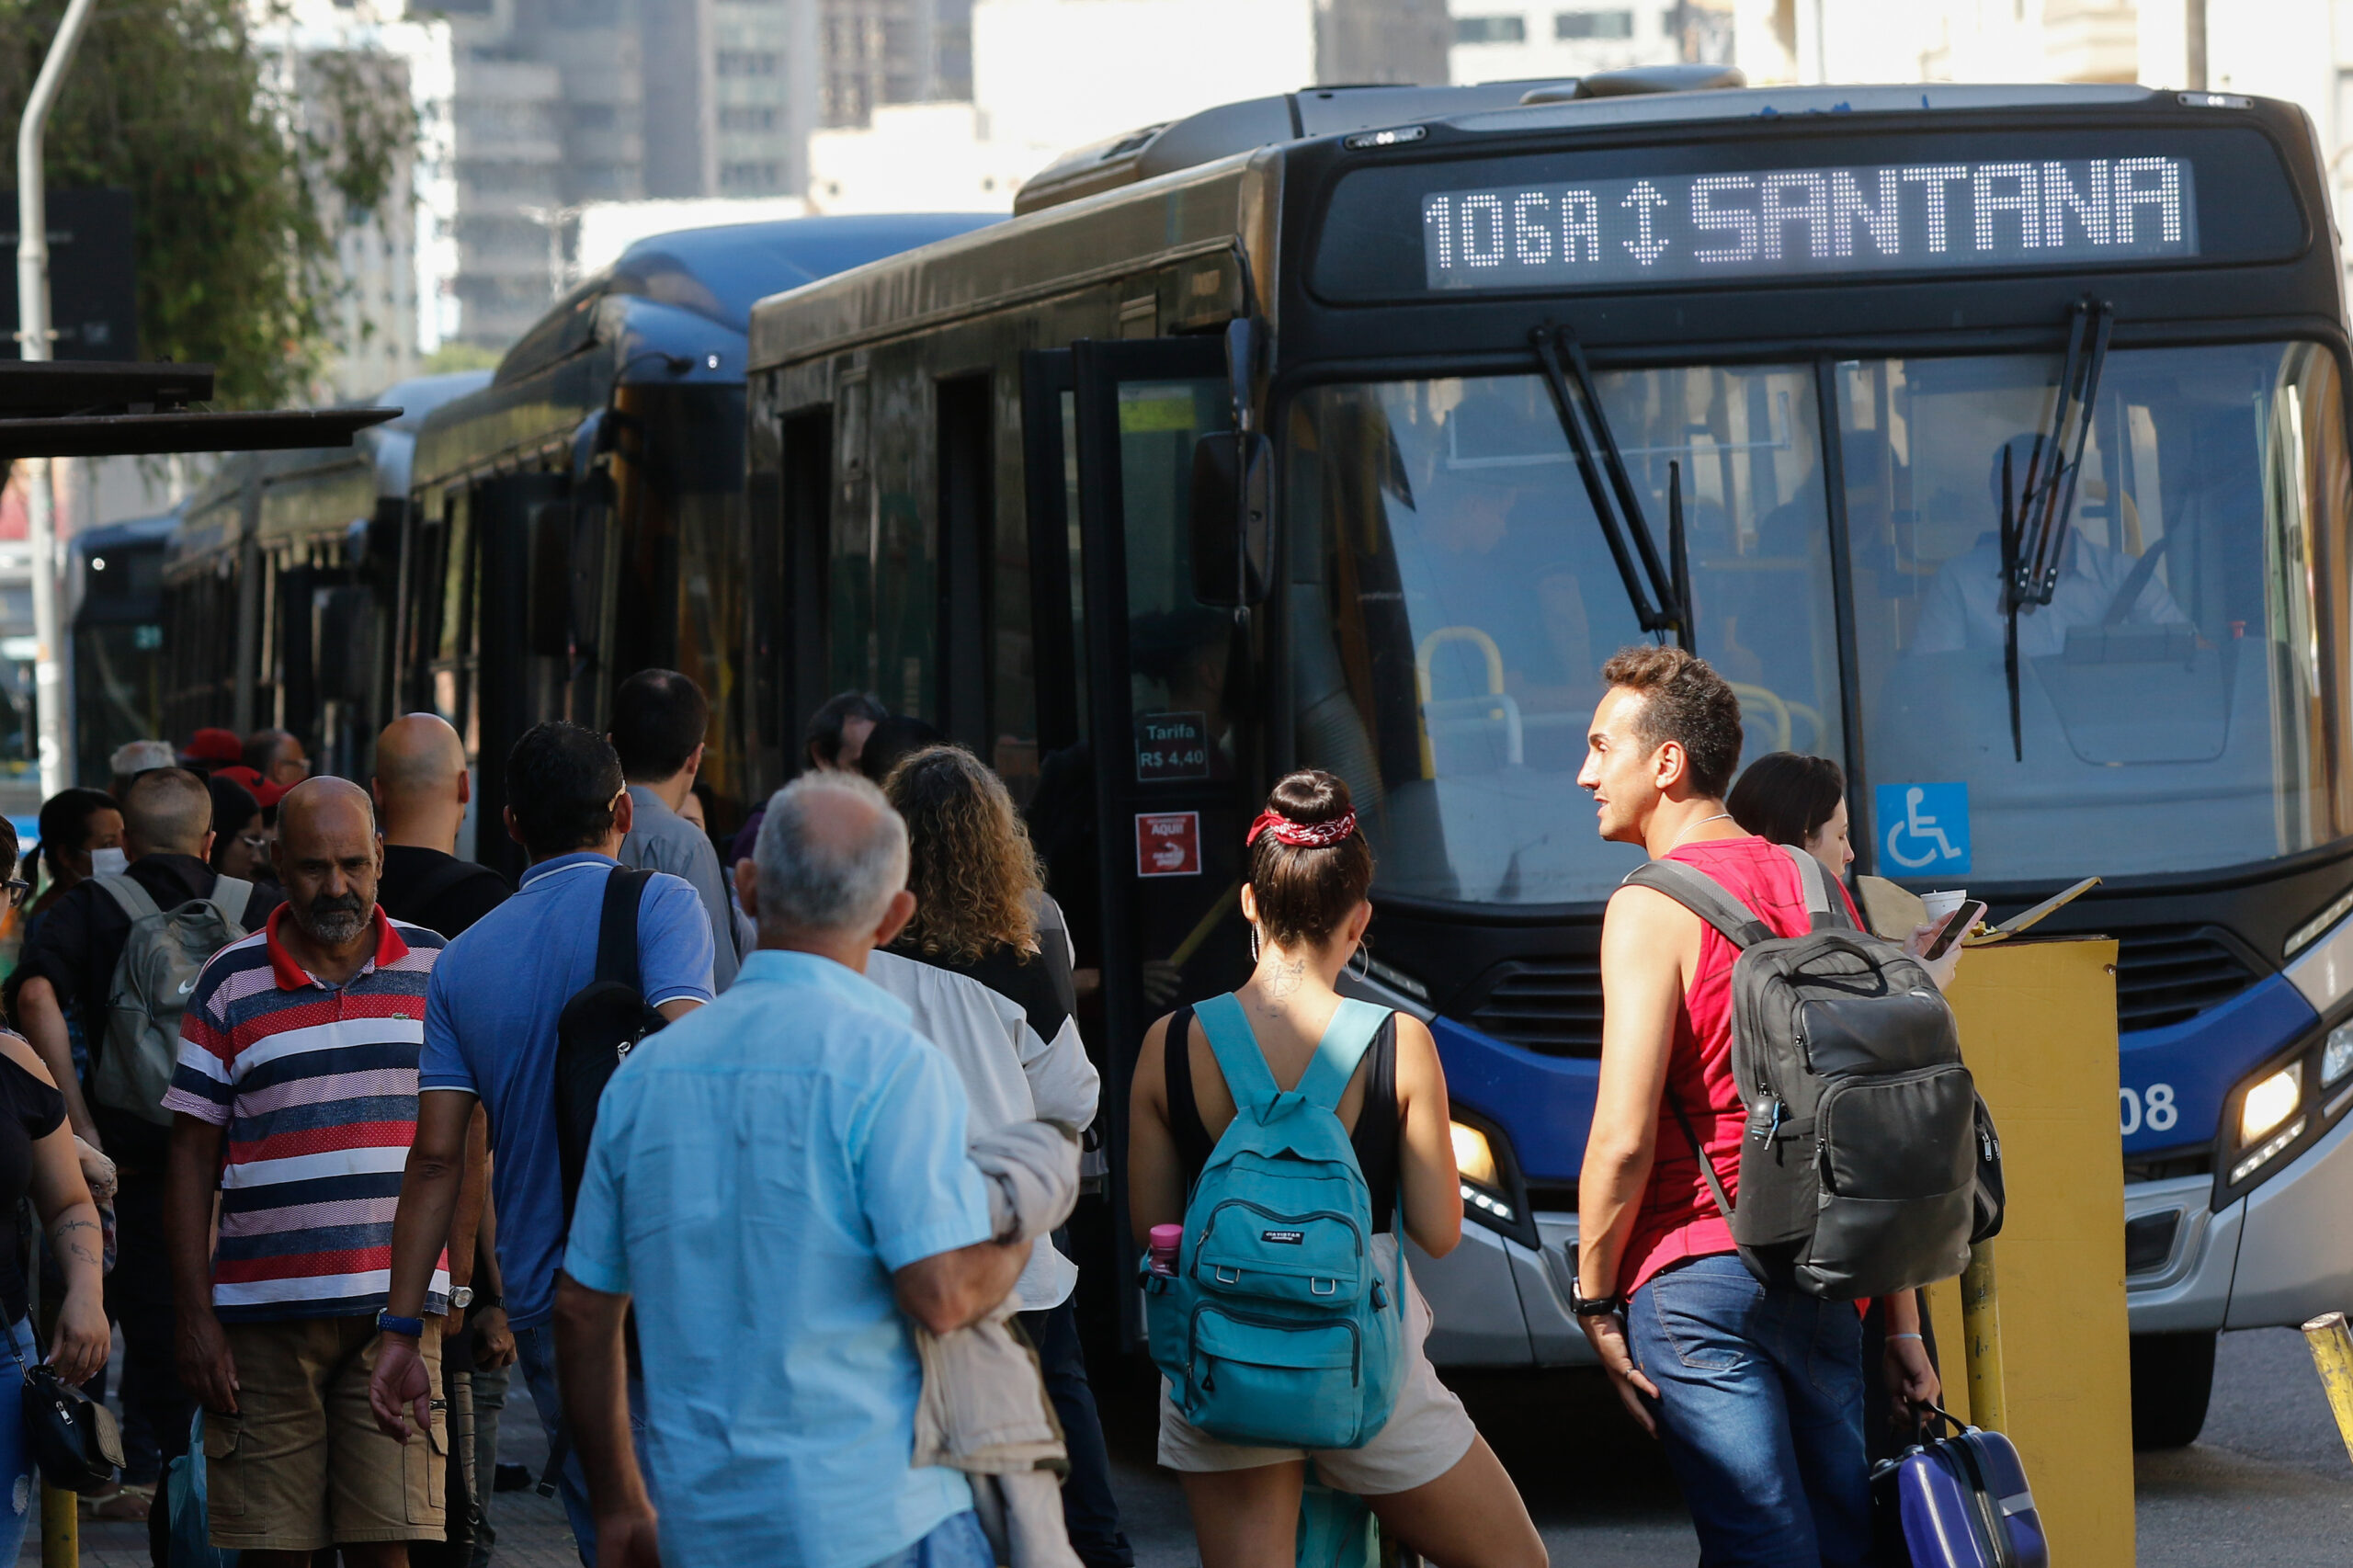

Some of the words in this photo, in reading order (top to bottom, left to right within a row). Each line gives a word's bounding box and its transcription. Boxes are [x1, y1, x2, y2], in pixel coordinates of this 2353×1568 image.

[1427, 189, 1600, 268] 106A
[1692, 156, 2183, 262] SANTANA
[1146, 723, 1195, 740] Tarifa
[1141, 751, 1164, 767] R$
[1168, 750, 1204, 767] 4,40
[2119, 1083, 2178, 1136] 08
